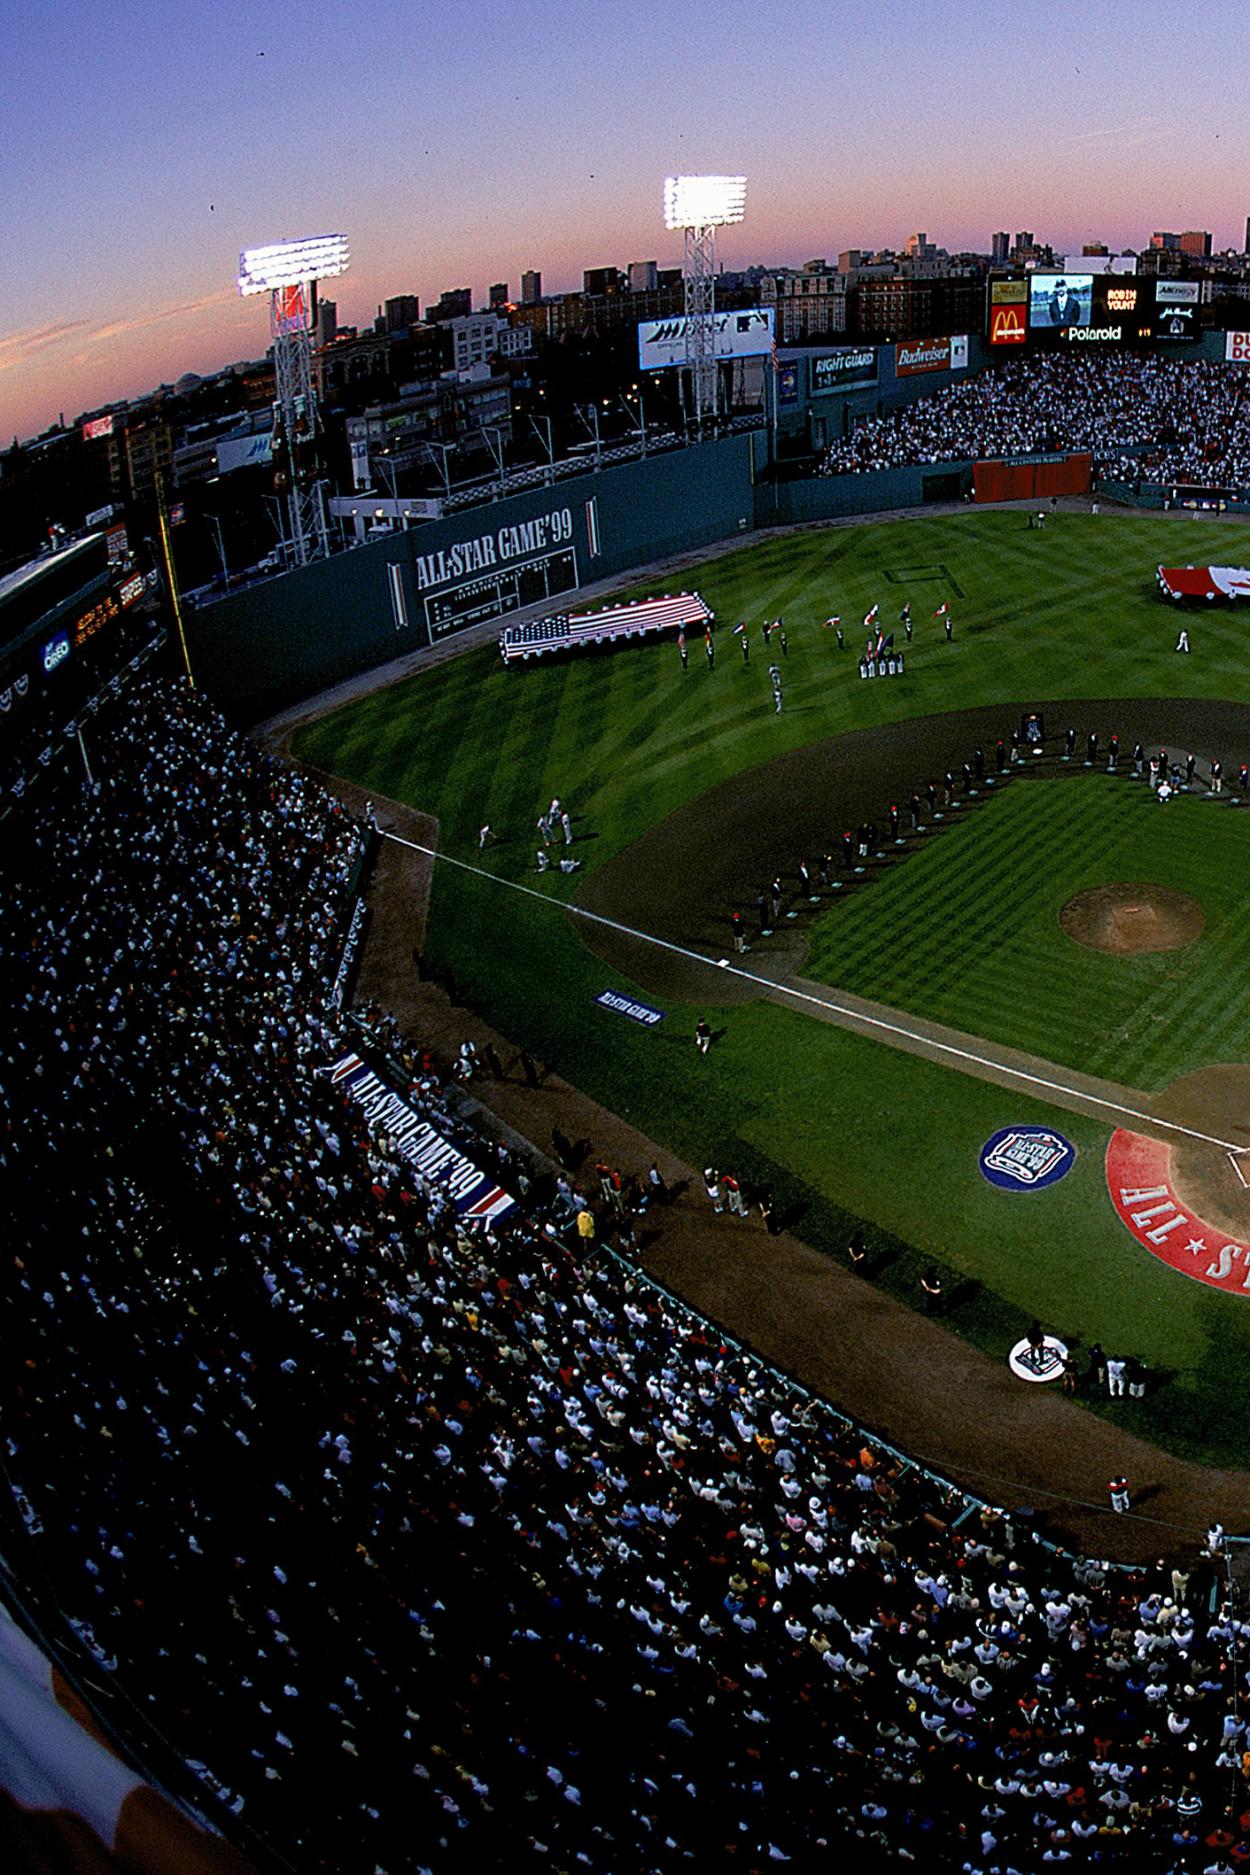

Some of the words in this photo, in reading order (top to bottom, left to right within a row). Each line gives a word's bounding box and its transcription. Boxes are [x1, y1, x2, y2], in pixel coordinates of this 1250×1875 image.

[1107, 289, 1137, 300] ROBIN
[1107, 300, 1136, 310] YOUNT
[1068, 326, 1121, 341] Polaroid
[815, 356, 845, 374] RIGHT
[844, 352, 874, 370] GUARD
[898, 347, 949, 366] Budweiser
[44, 641, 69, 671] OREO
[1120, 1184, 1188, 1246] ALL
